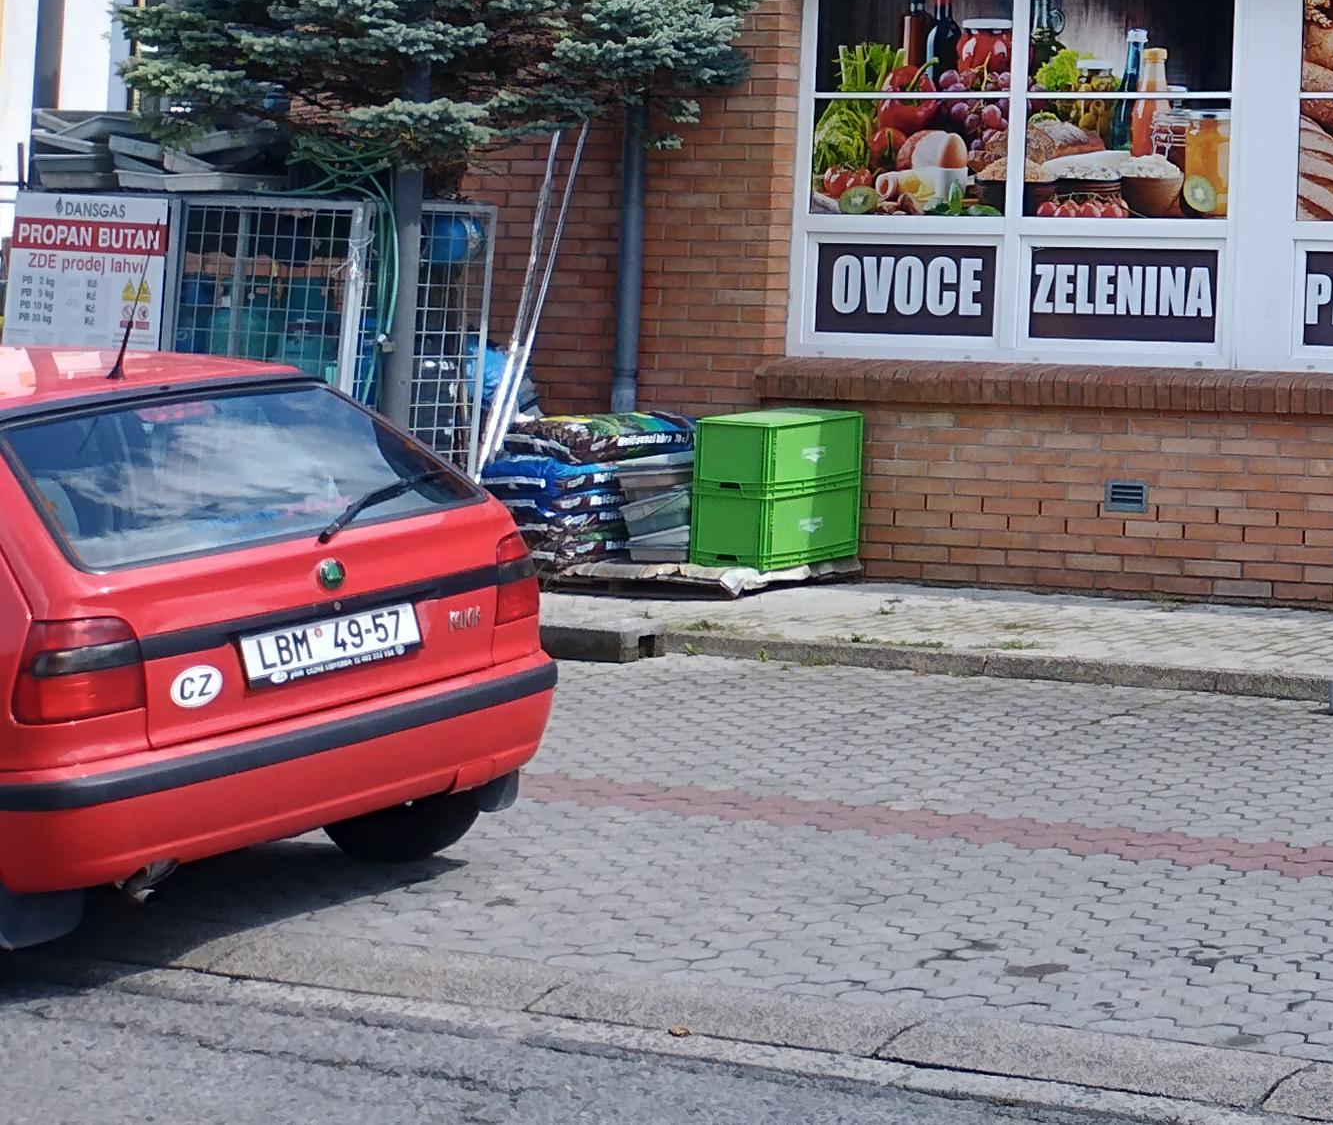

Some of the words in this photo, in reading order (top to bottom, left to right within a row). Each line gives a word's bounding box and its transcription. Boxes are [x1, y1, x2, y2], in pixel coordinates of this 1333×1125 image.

[65, 202, 126, 219] DANSGAS
[18, 223, 92, 247] PROPAN
[98, 227, 160, 250] BUTAN
[28, 253, 57, 269] ZDE
[62, 256, 106, 275] prodej
[832, 254, 983, 316] OVOCE
[1033, 263, 1213, 317] ZELENINA
[256, 628, 313, 670] LBM
[333, 610, 402, 652] 49-57
[179, 673, 213, 700] CZ
